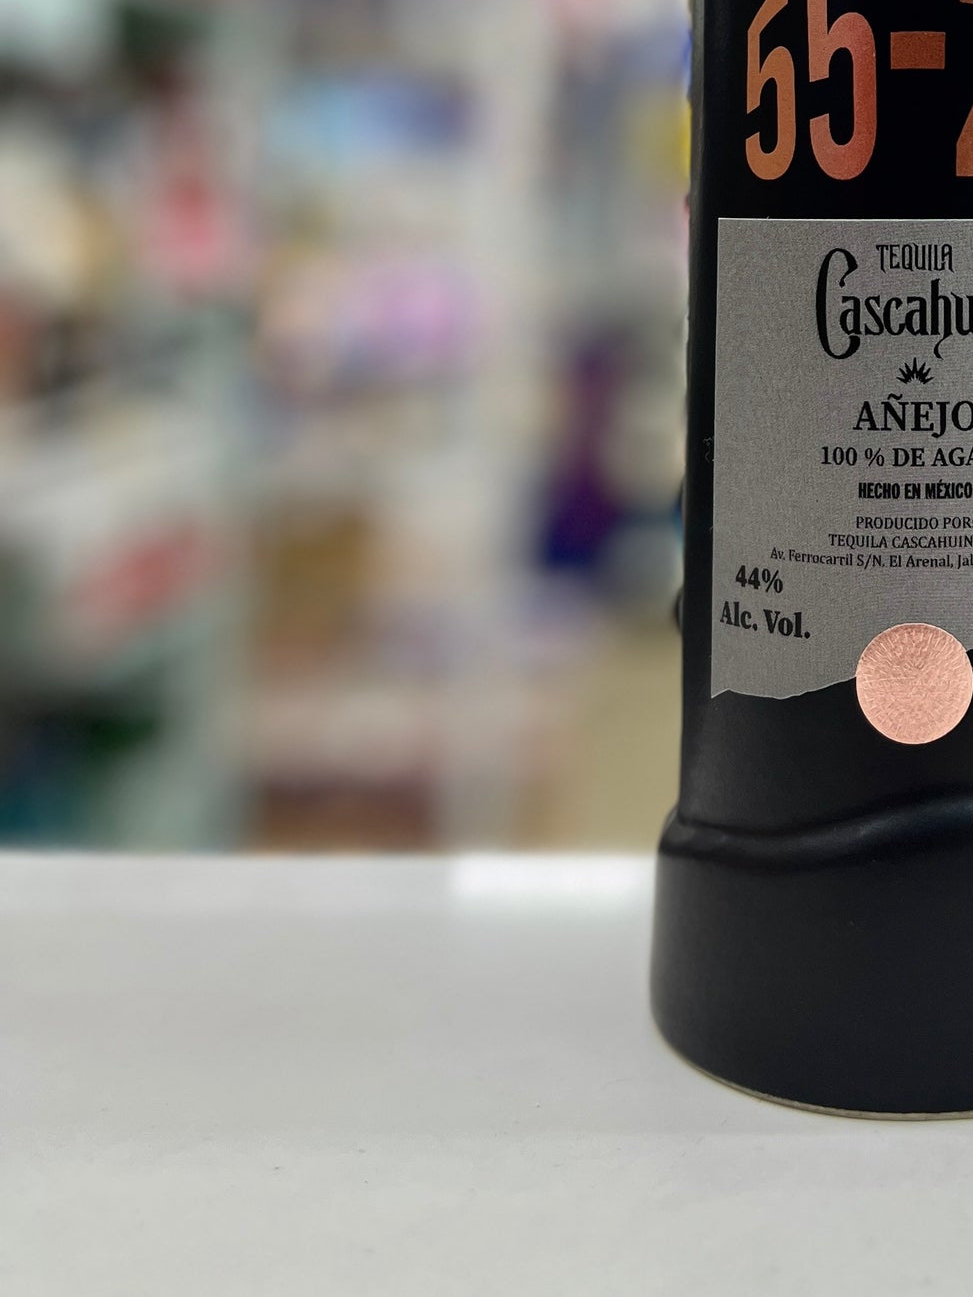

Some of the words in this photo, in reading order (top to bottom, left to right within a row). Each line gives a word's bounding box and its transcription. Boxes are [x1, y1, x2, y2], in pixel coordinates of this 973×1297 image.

[876, 244, 955, 272] TEQUILA
[820, 446, 858, 466] 100
[864, 446, 885, 467] %
[892, 446, 926, 467] DE
[858, 482, 900, 500] HECHO
[905, 482, 921, 500] EN
[925, 479, 973, 500] MÉXICO
[855, 516, 939, 530] PRODUCIDO
[828, 534, 888, 549] TEQUILA
[770, 546, 787, 561] Av.
[788, 549, 853, 567] Ferrocarril
[856, 553, 886, 569] S/N.
[890, 554, 903, 568] El
[906, 553, 953, 570] Arenal,
[735, 565, 784, 593] 44%
[720, 601, 758, 631] Alc.
[763, 608, 811, 639] Vol.
